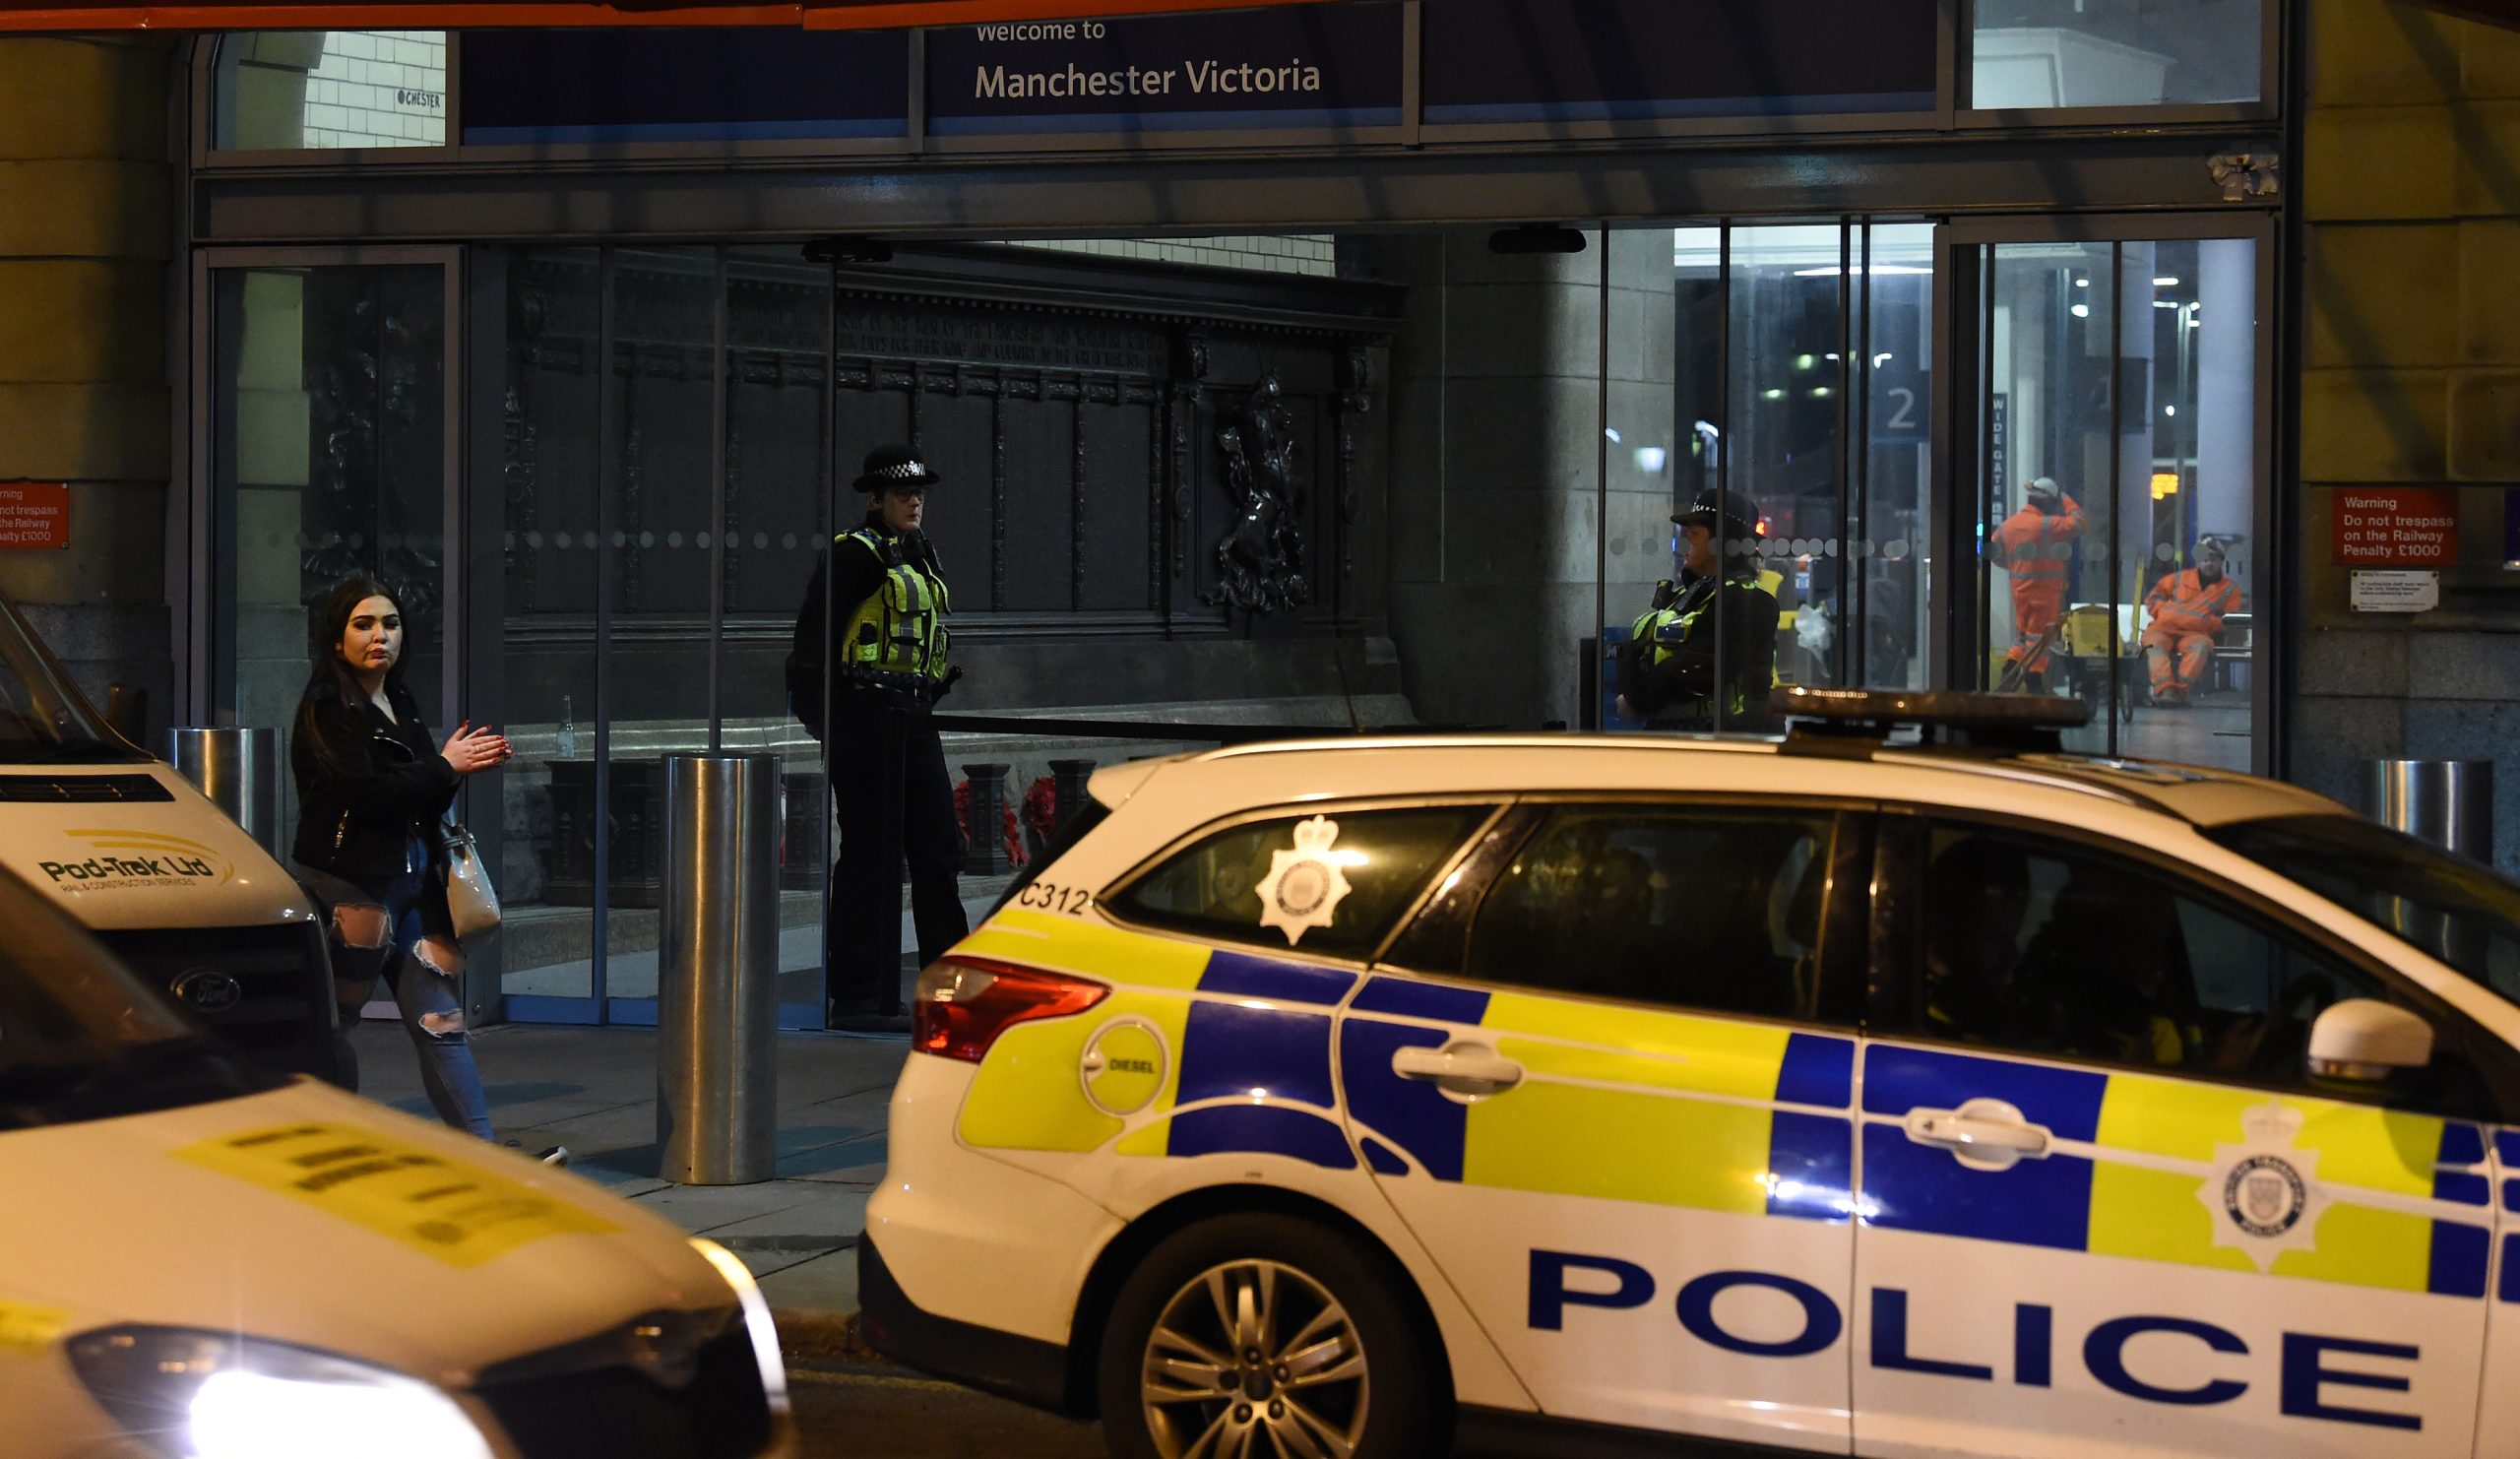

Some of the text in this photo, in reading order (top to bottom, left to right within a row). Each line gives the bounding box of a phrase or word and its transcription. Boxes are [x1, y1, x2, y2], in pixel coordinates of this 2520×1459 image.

[976, 21, 1105, 41] Welcome to
[976, 58, 1321, 97] Manchester Victoria
[406, 92, 441, 107] CHESTER
[1888, 388, 1915, 428] 2
[1992, 398, 2004, 495] WIDE GATE
[0, 490, 23, 501] rning
[17, 505, 58, 517] trespass
[2345, 496, 2397, 511] Warning
[15, 518, 50, 530] Railway
[2344, 514, 2454, 529] Do not trespass
[21, 531, 51, 541] £1000
[2344, 530, 2444, 543] on the Railway
[2344, 543, 2441, 558] Penalty £1000
[38, 856, 214, 882] Pod-Trak Ltd
[1020, 882, 1089, 916] C312
[1109, 1058, 1155, 1074] DIESEL
[1528, 1248, 2424, 1431] POLICE
